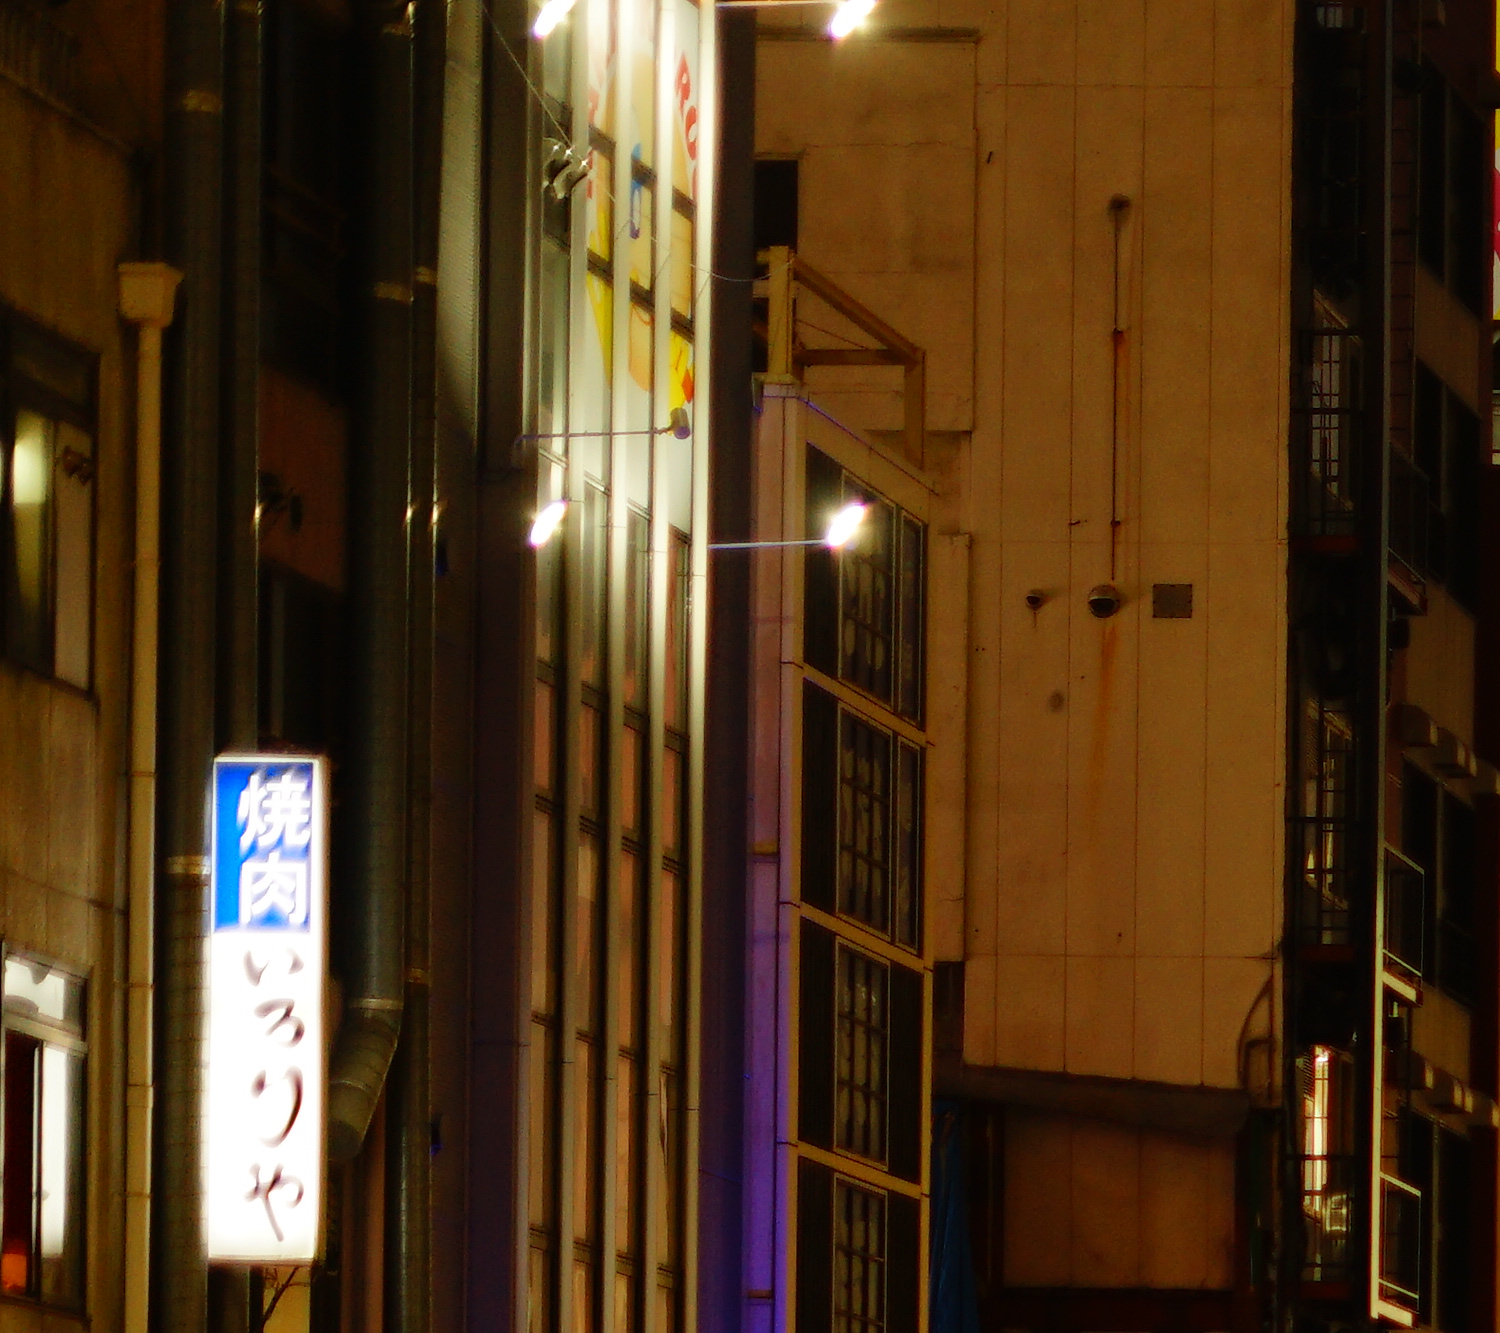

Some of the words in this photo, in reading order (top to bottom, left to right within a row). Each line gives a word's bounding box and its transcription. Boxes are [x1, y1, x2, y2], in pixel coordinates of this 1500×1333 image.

[238, 770, 311, 928] 焼肉
[243, 948, 305, 1243] いろりや
